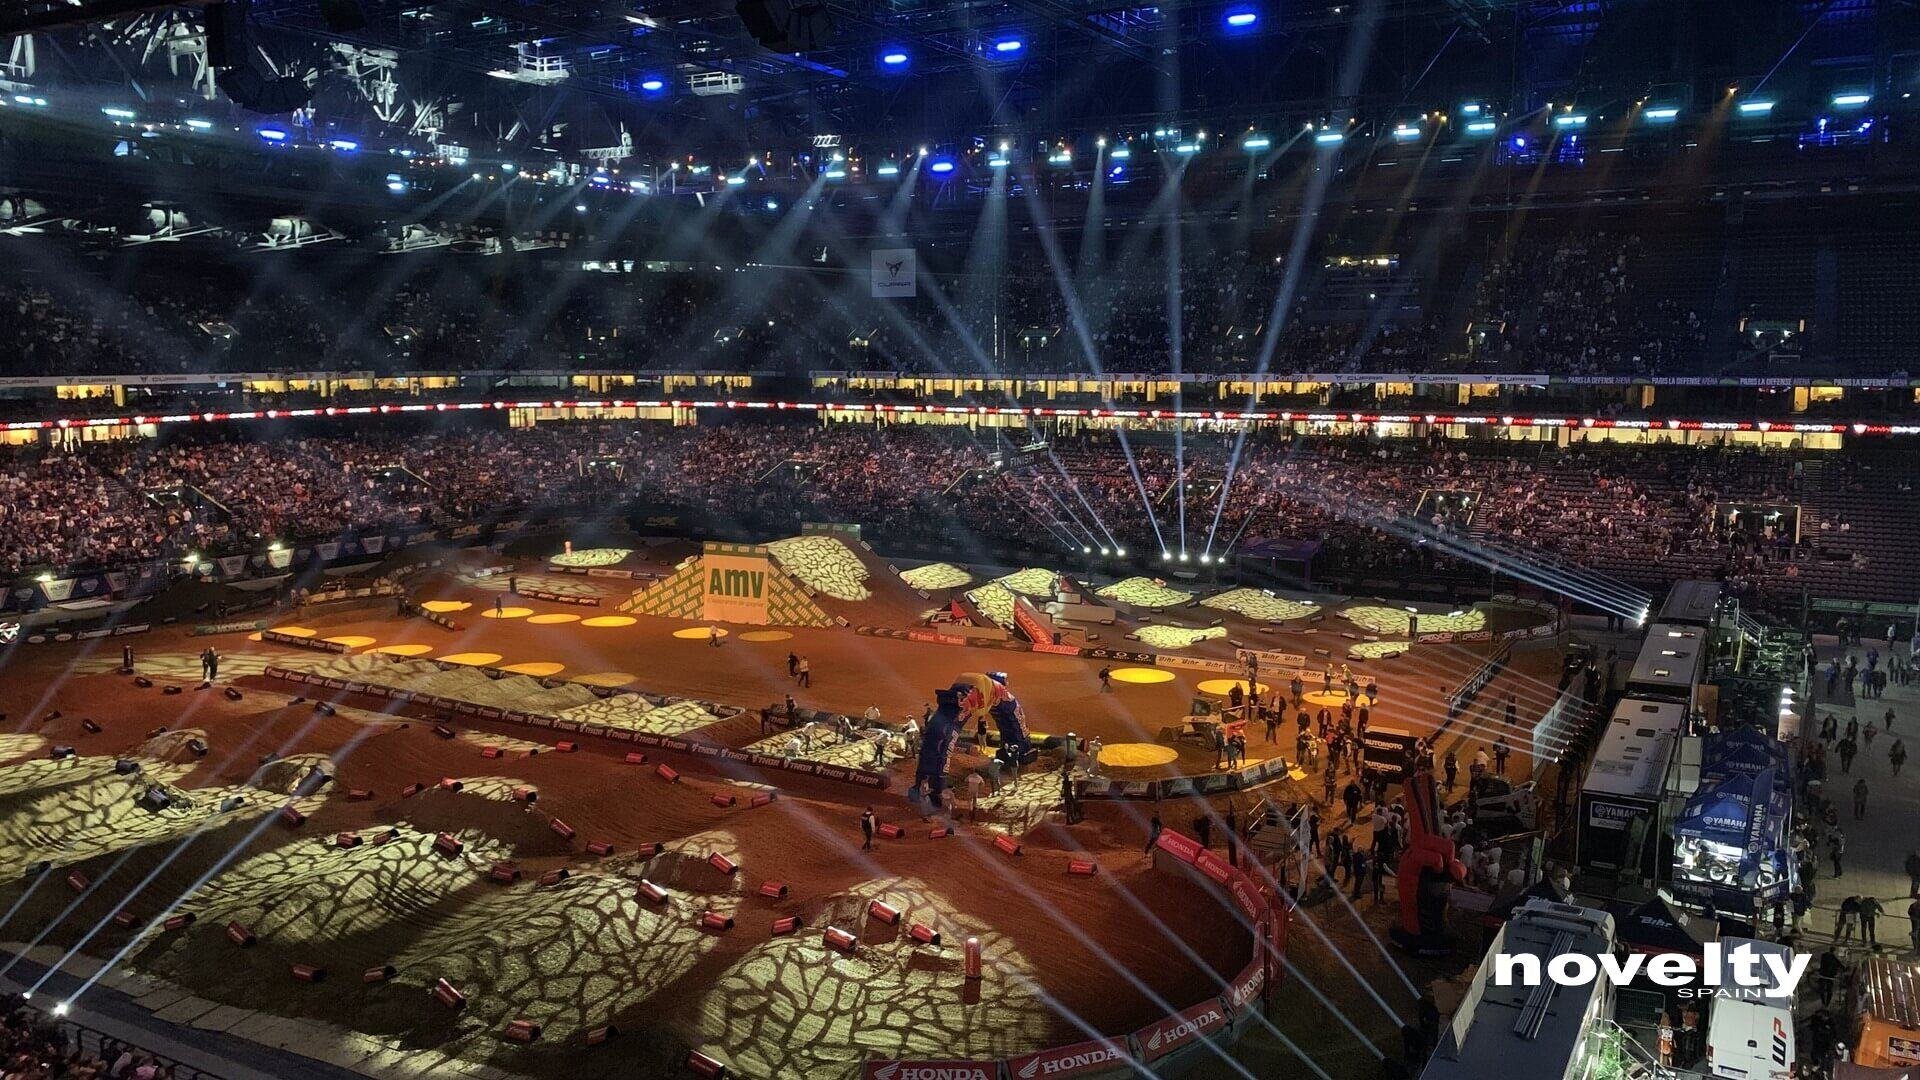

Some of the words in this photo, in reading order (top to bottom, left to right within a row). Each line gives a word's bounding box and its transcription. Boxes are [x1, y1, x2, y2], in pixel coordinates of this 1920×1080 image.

[1568, 376, 1582, 384] PARIS
[1652, 377, 1668, 385] PARIS
[1834, 378, 1851, 386] PARIS
[1010, 454, 1034, 467] FINISH
[1364, 738, 1404, 750] AUTOMOTO
[700, 746, 718, 755] THOR
[728, 750, 750, 761] THOR
[759, 756, 780, 767] THOR
[790, 762, 812, 772] THOR
[822, 768, 845, 778] THOR
[856, 774, 879, 786] THOR
[1750, 804, 1764, 842] YAMAHA
[1167, 838, 1195, 858] HONDA
[1204, 860, 1230, 880] HONDA
[1237, 886, 1257, 918] HONDA
[1162, 1009, 1221, 1045] HONDA
[1043, 1046, 1122, 1075] HONDA
[900, 1068, 990, 1080] HONDA
